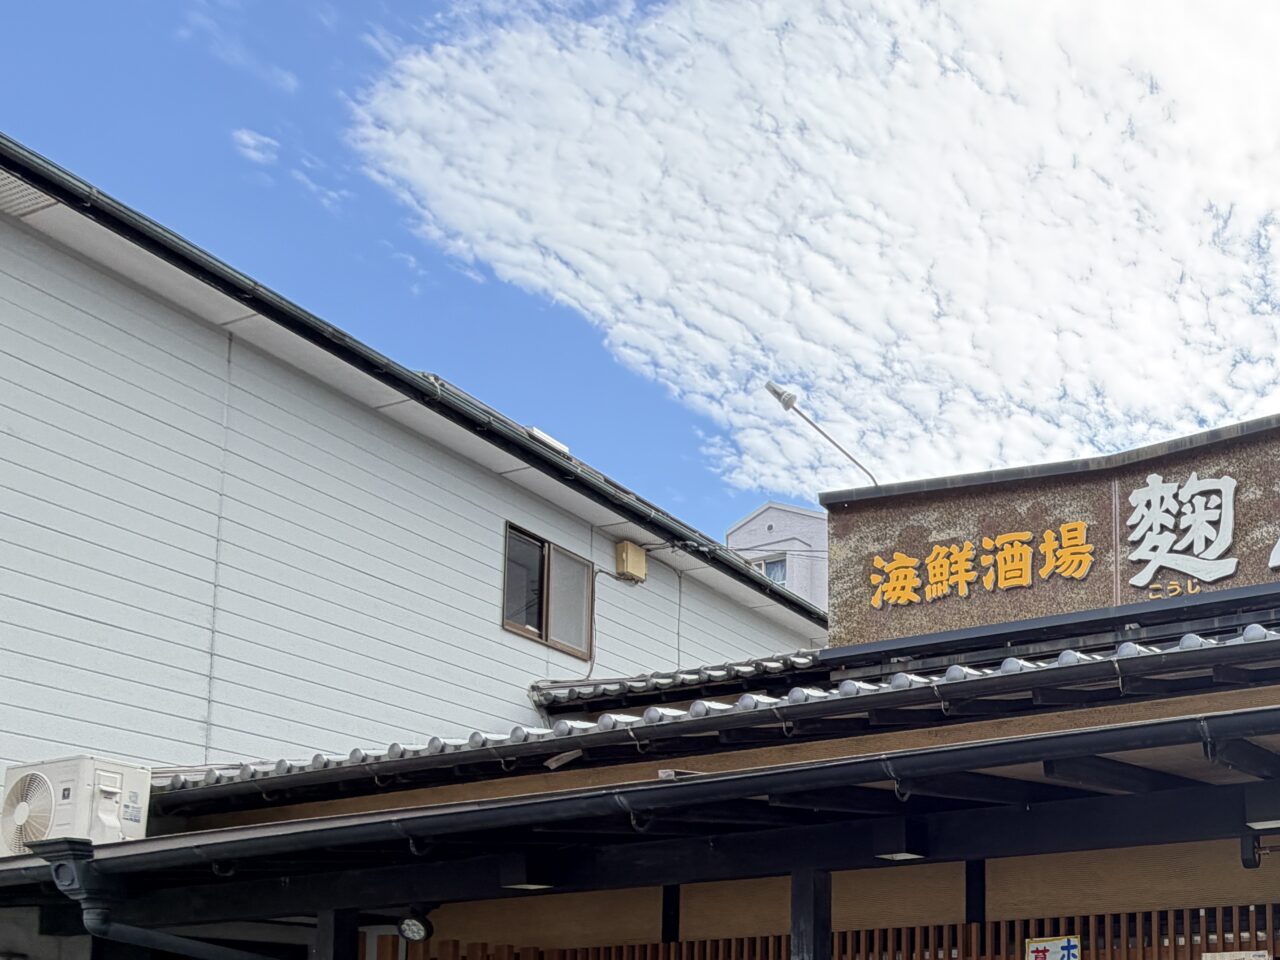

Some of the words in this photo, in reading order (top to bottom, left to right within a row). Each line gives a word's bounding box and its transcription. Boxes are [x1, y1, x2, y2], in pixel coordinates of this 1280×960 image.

[870, 520, 1096, 608] 海鮮酒場
[1148, 578, 1201, 600] こうじ
